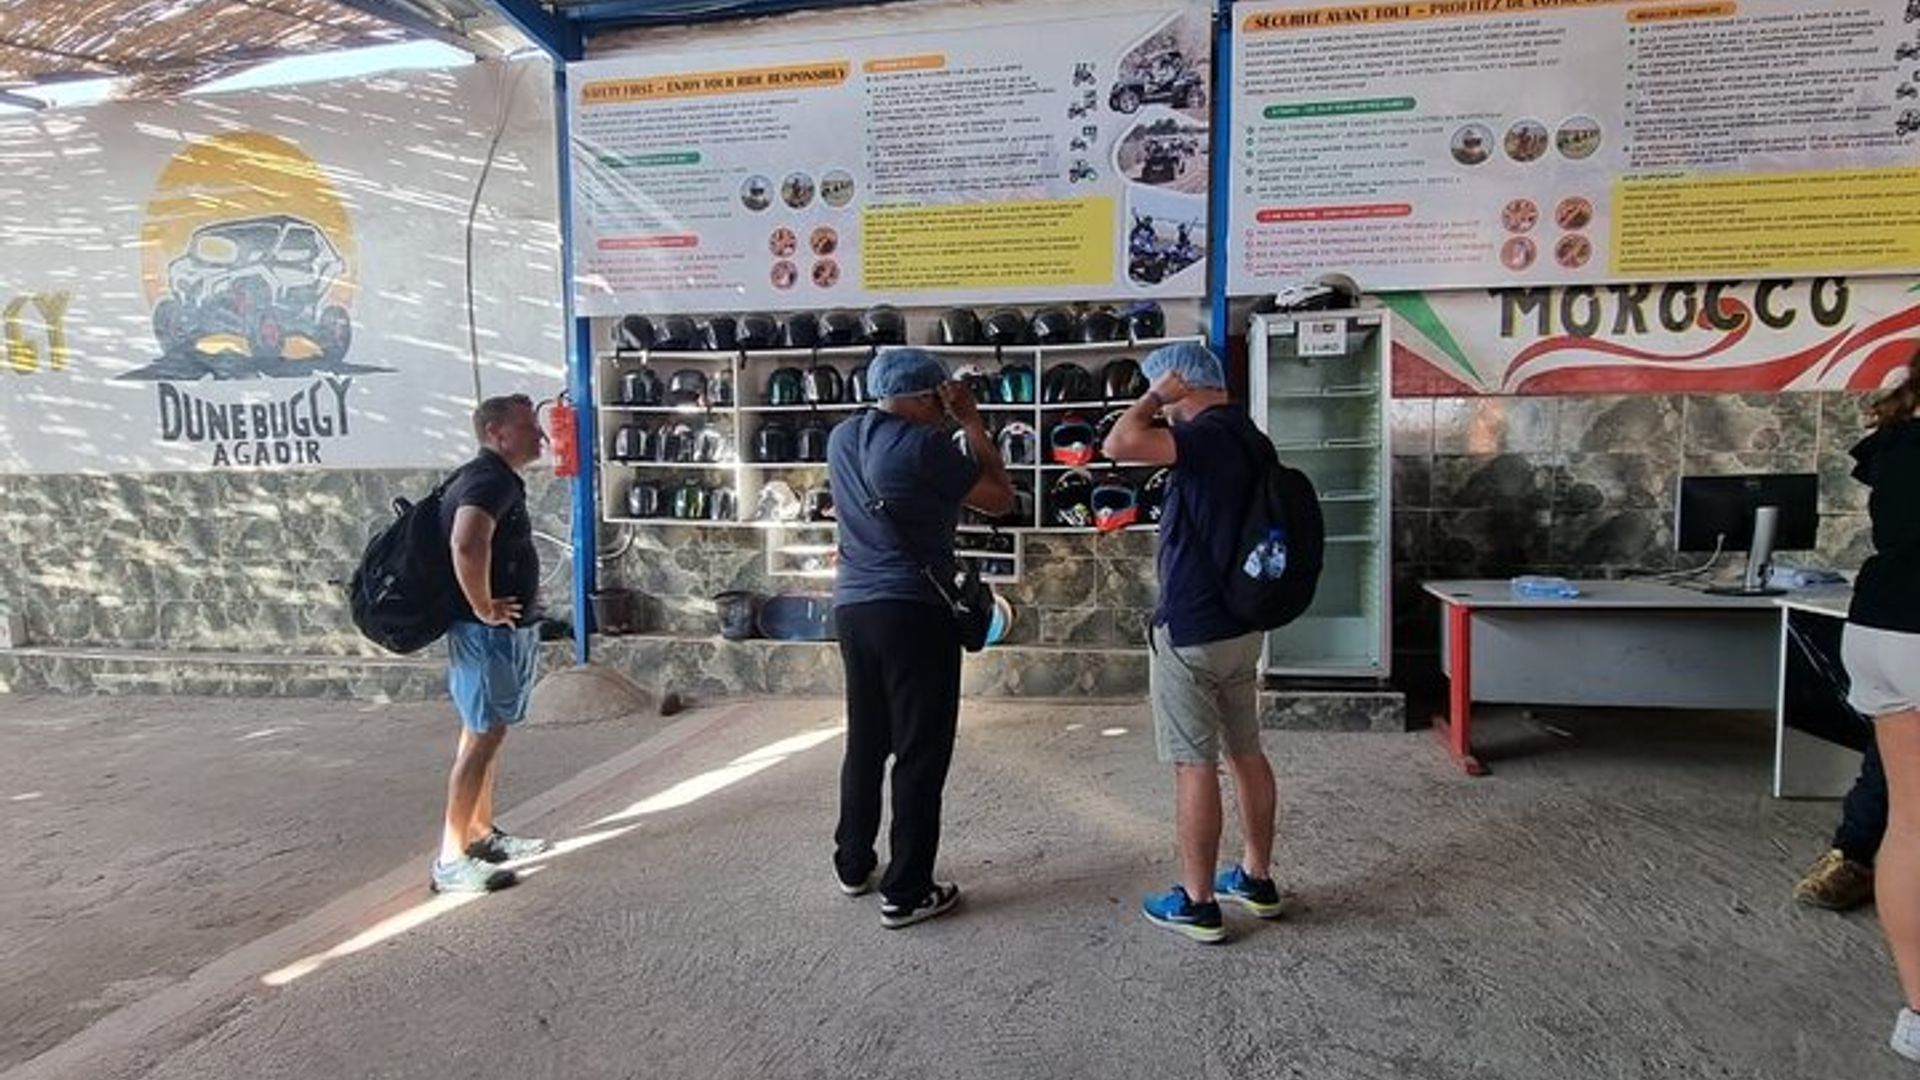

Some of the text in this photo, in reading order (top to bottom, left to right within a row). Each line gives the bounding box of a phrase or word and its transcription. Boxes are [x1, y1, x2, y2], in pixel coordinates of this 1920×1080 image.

[1326, 8, 1370, 23] AVANT
[1375, 5, 1411, 18] TOUT
[1429, 0, 1499, 16] PROFITEZ
[624, 82, 654, 96] FIRST
[667, 80, 701, 93] ENJOY
[704, 76, 734, 88] YOUR
[737, 75, 762, 86] RIDE
[1488, 274, 1848, 338] MOROCCO
[157, 377, 353, 441] DUNE BUGGY
[212, 441, 322, 467] AGADIR
